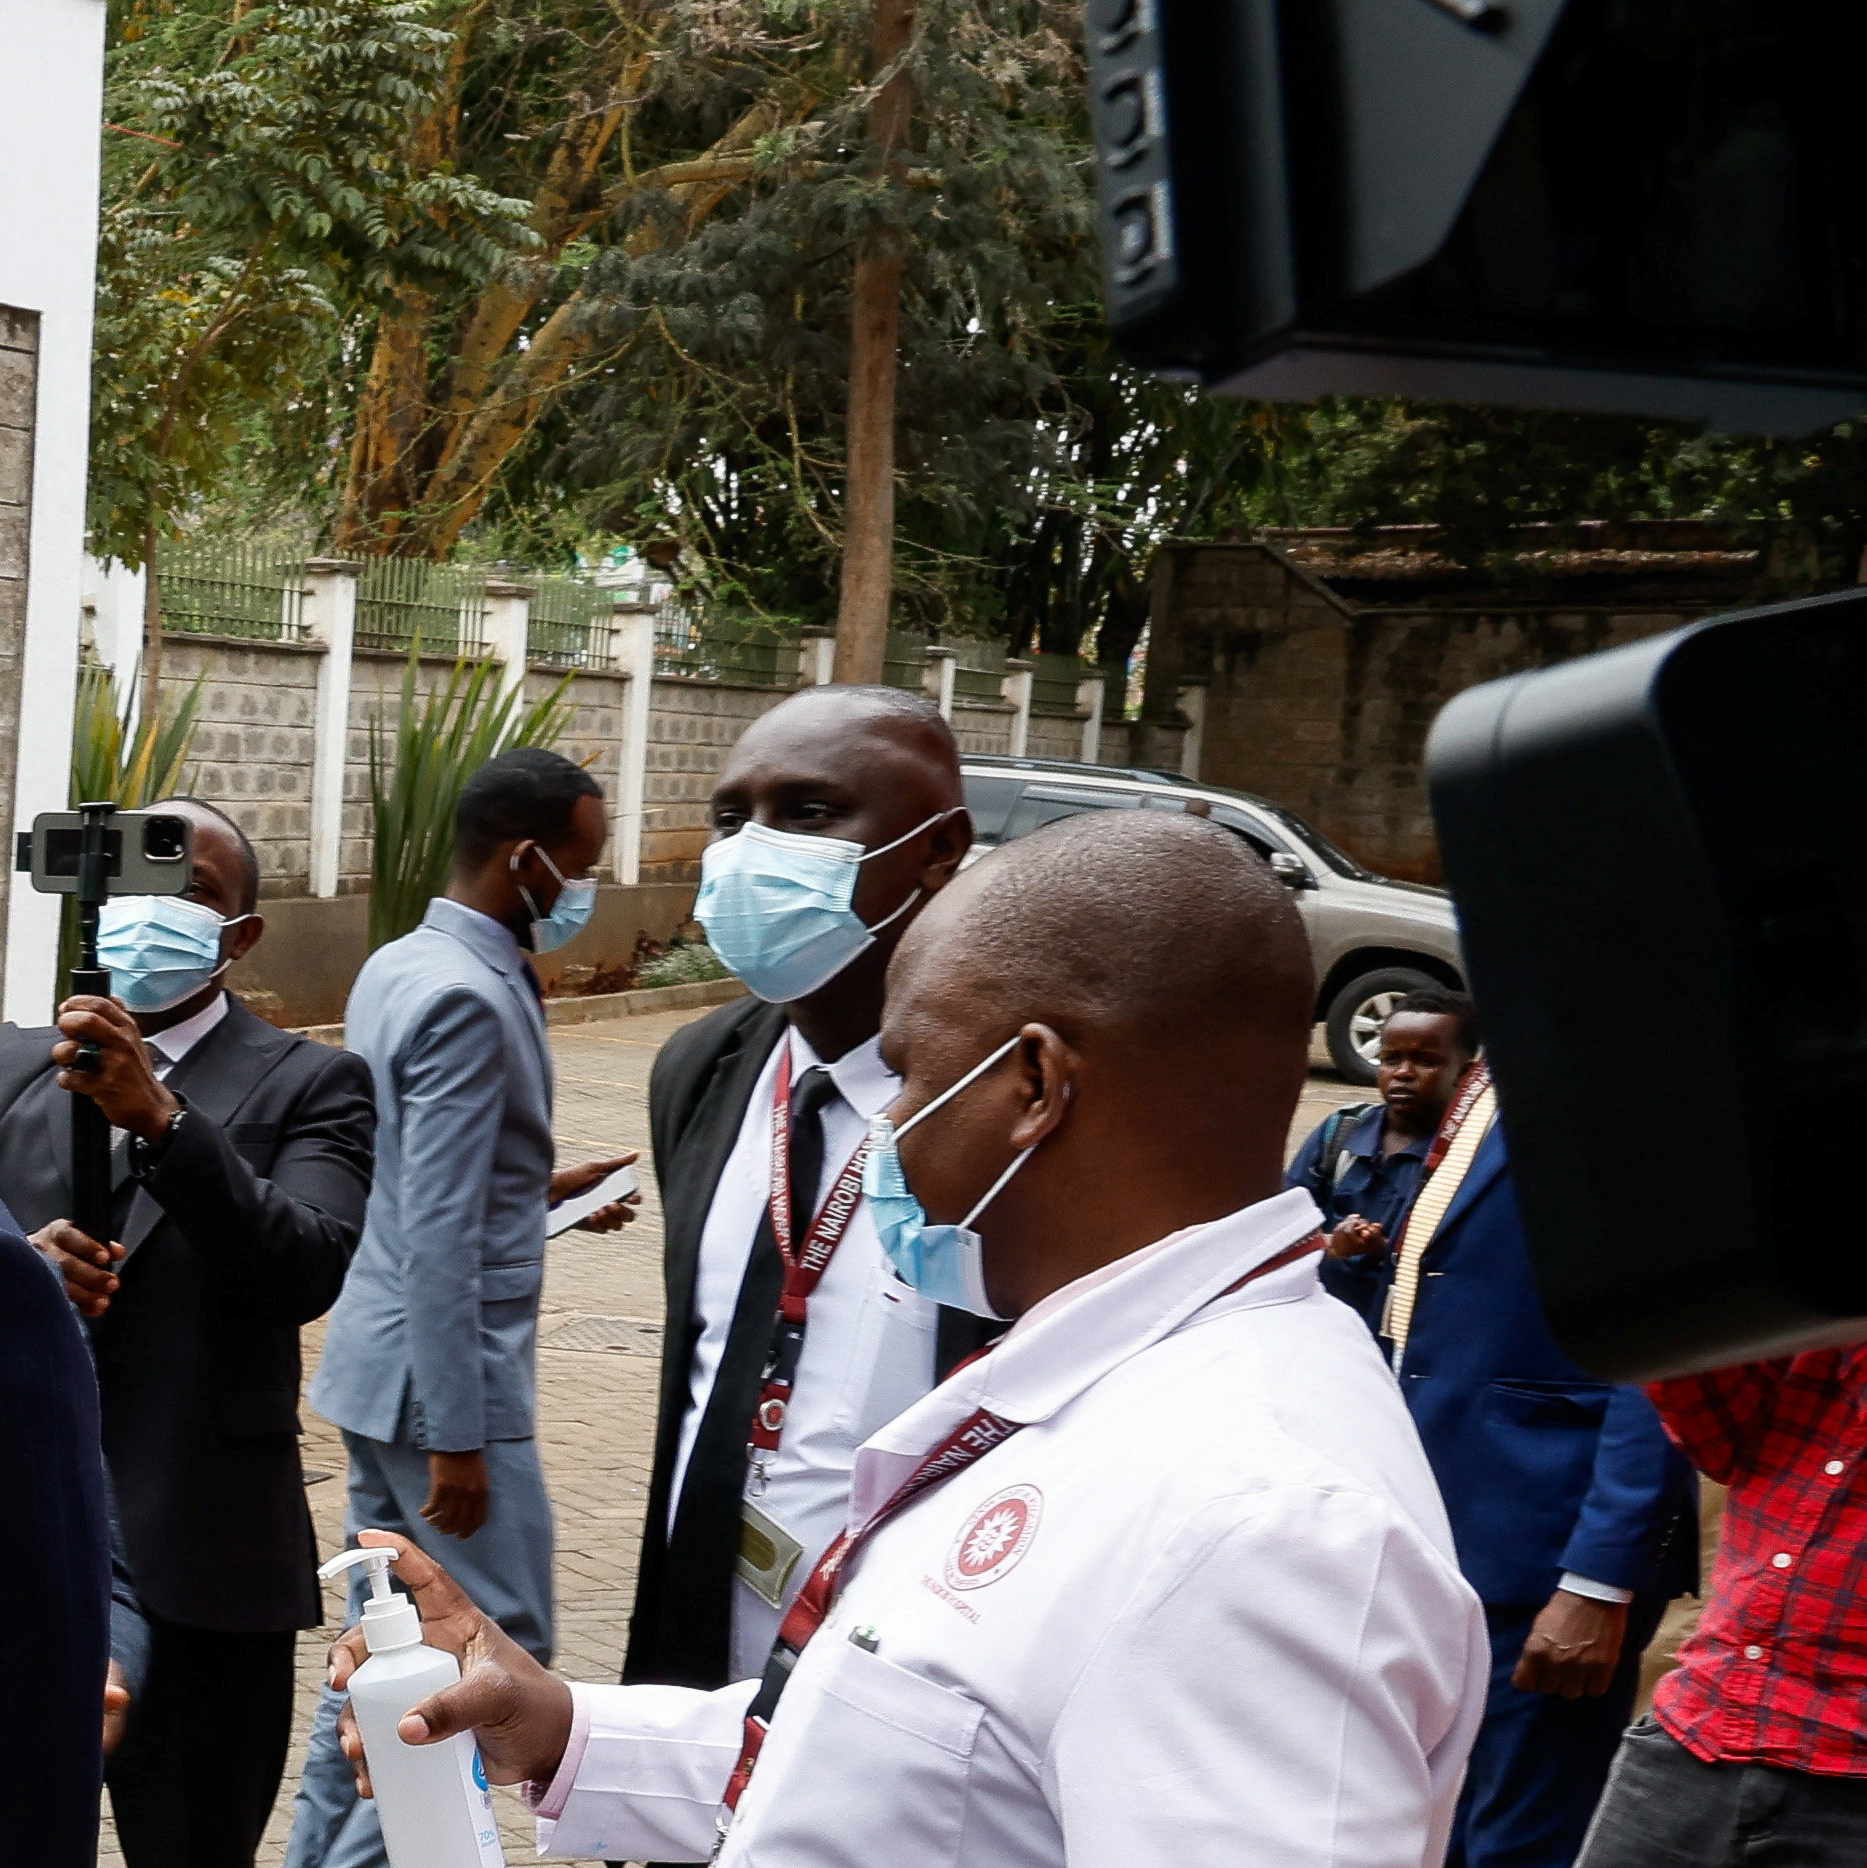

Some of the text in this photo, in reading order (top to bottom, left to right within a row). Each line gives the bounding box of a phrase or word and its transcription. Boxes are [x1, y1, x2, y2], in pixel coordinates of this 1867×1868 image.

[815, 1174, 863, 1242] NAIROBI
[799, 1239, 833, 1271] THE
[960, 1413, 1015, 1451] THE
